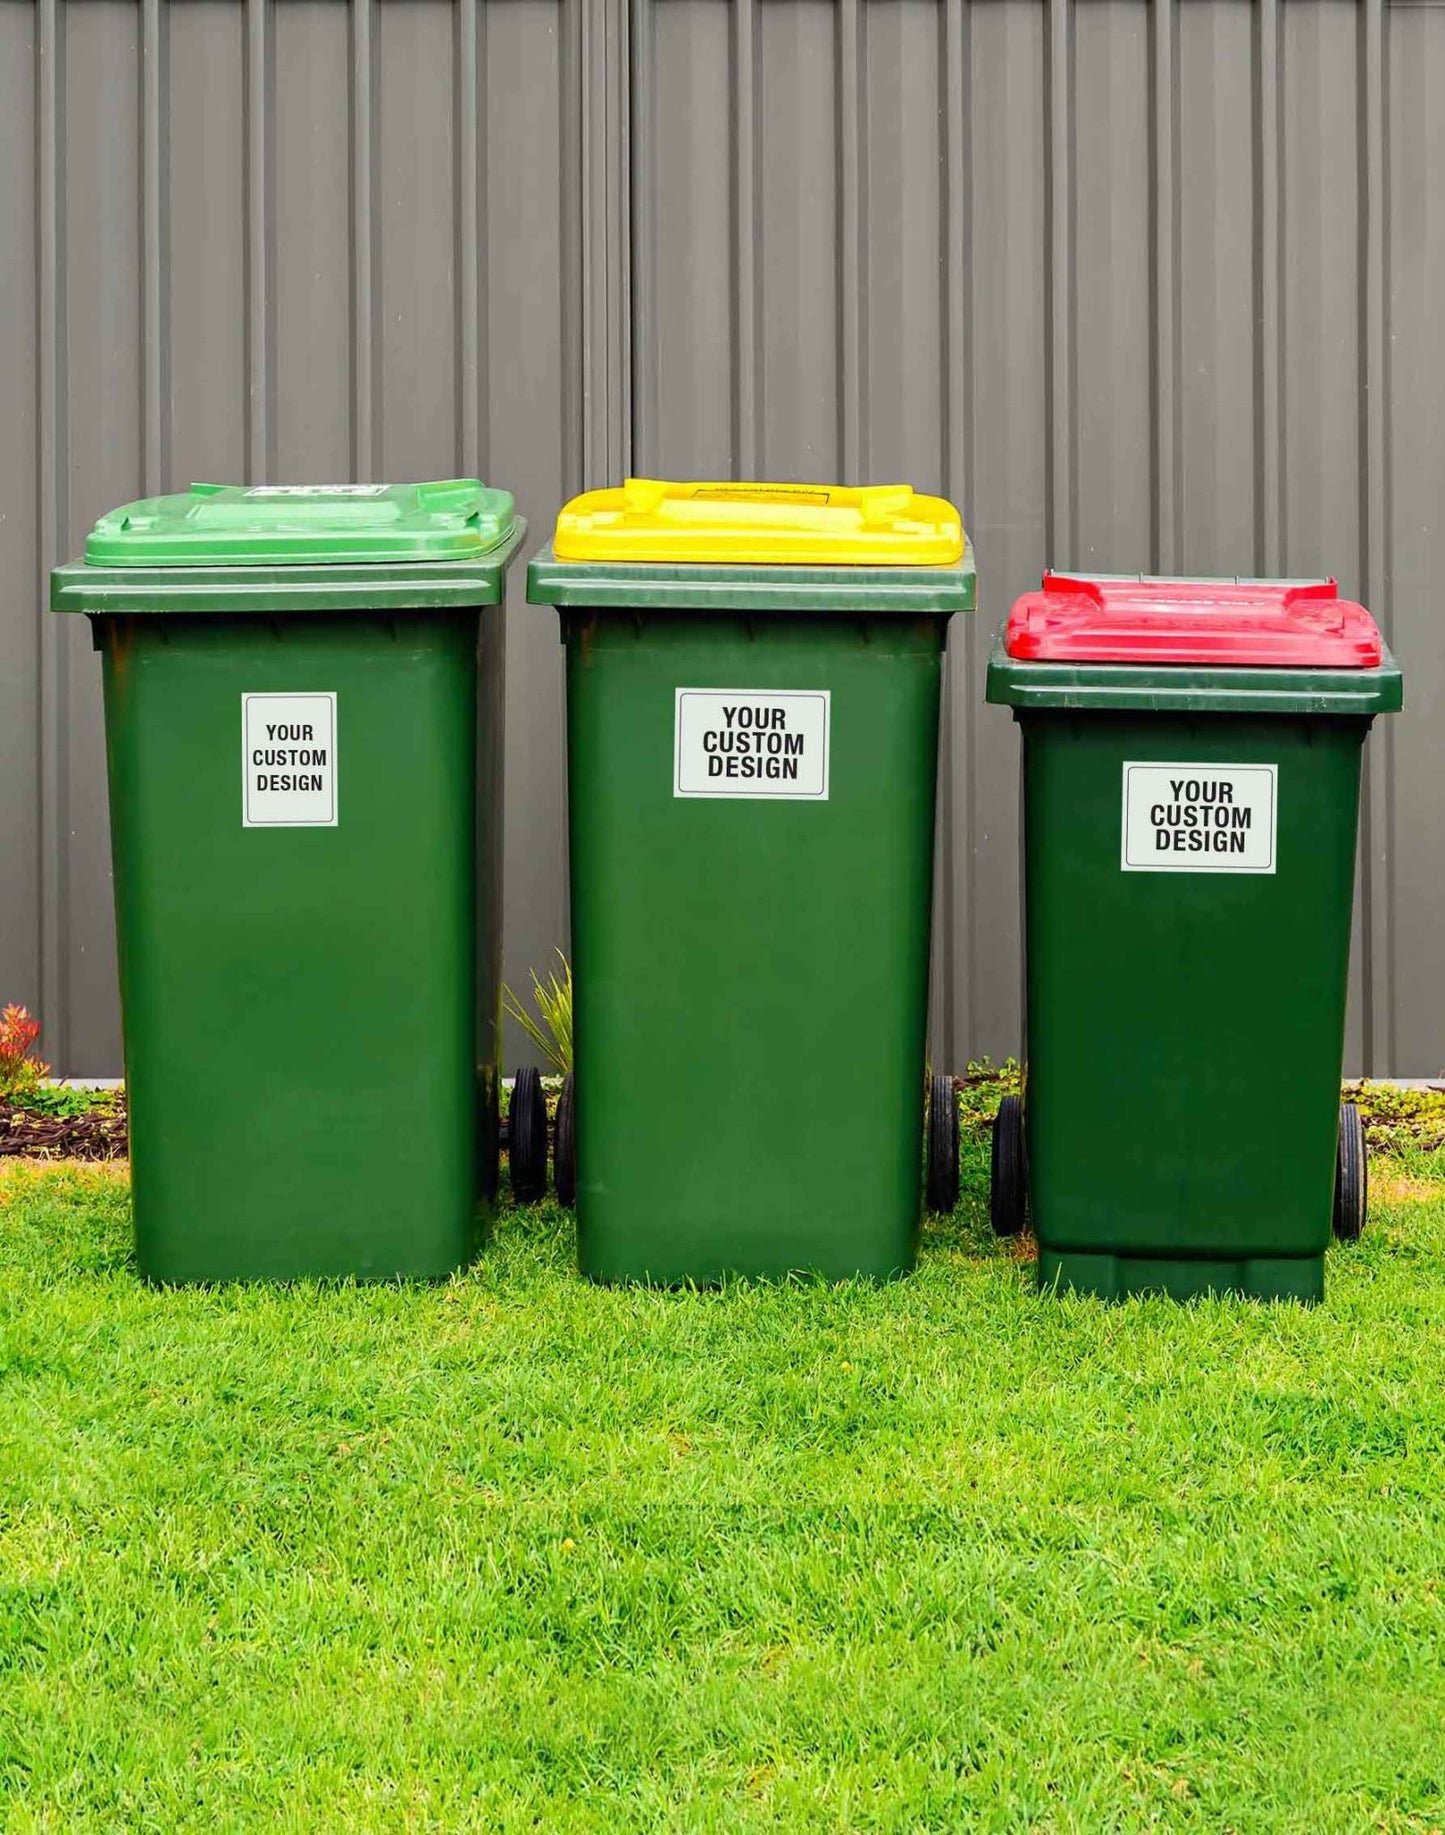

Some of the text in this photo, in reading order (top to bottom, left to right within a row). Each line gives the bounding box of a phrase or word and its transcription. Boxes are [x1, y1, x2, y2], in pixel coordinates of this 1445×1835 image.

[723, 706, 786, 730] YOUR
[266, 725, 313, 741] YOUR
[703, 731, 805, 755] CUSTOM
[253, 750, 327, 766] CUSTOM
[709, 756, 798, 780] DESIGN
[258, 775, 323, 791] DESIGN
[1170, 780, 1233, 804] YOUR
[1150, 804, 1252, 829] CUSTOM
[1156, 829, 1245, 853] DESIGN
